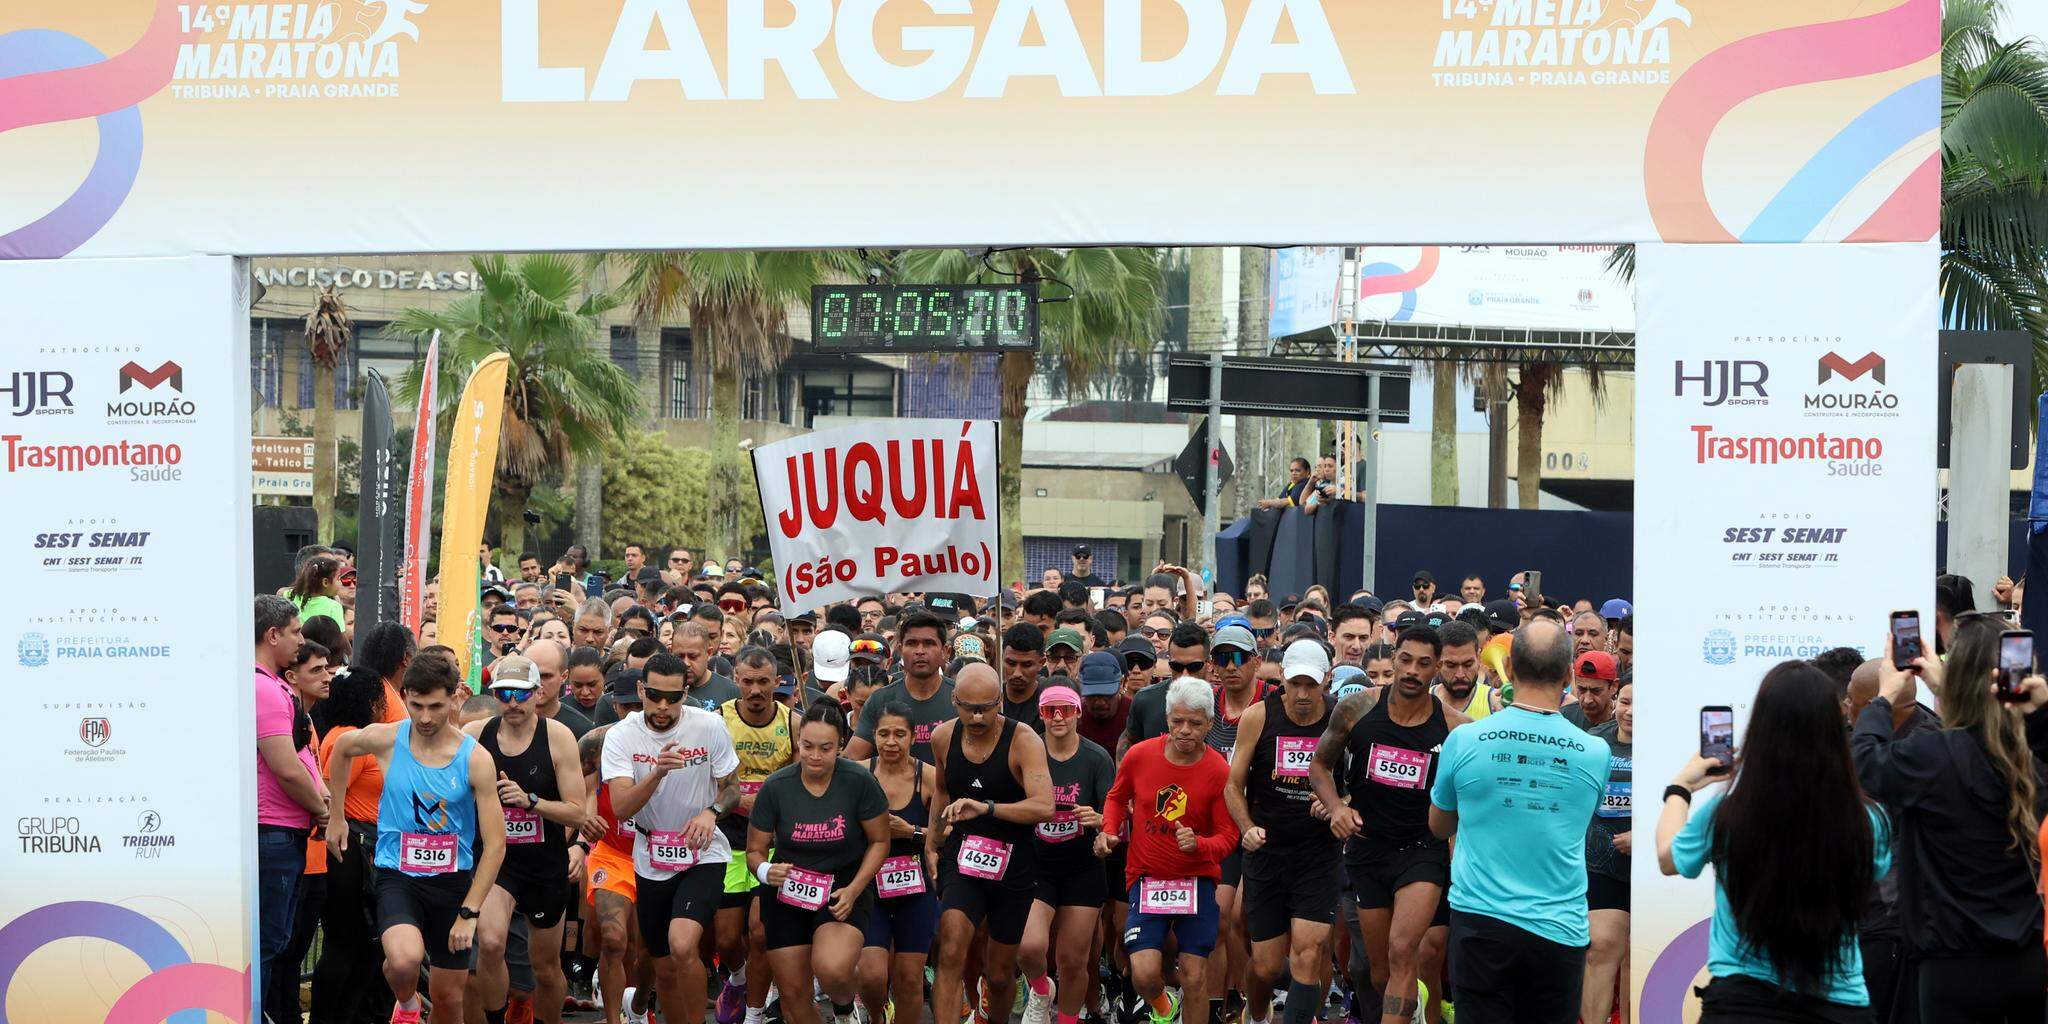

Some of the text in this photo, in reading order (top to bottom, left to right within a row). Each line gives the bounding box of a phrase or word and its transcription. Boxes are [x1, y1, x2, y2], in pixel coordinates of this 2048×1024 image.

[227, 3, 335, 40] MEIA
[502, 0, 1357, 102] LARGADA
[1432, 27, 1671, 67] MARATONA
[172, 41, 400, 80] MARATONA
[1432, 70, 1671, 87] TRIBUNA PRAIA GRANDE
[171, 83, 399, 99] TRIBUNA PRAIA GRANDE
[379, 270, 414, 290] DE
[416, 270, 486, 291] ASSI
[822, 291, 1026, 337] 07:05:00
[1674, 360, 1770, 407] HJR
[108, 398, 195, 417] MOURÃO
[1726, 397, 1770, 407] SPORTS
[1805, 391, 1898, 409] MOURÃO
[34, 407, 75, 417] SPORTS
[1690, 425, 1883, 464] Trasmontano
[2, 435, 182, 472] Trasmontano
[130, 466, 182, 482] Saúde
[1827, 458, 1883, 477] Saúde
[293, 479, 312, 488] Gra
[778, 421, 986, 539] JUQUIÁ
[34, 532, 150, 548] SEST SENAT
[1723, 528, 1847, 543] SEST SENAT
[68, 557, 92, 565] SEST
[94, 557, 124, 565] SENAT
[1759, 553, 1784, 561] SEST
[785, 541, 992, 604] (São Paulo)
[69, 608, 118, 616] APOIO
[56, 637, 130, 645] PREFEITURA
[1744, 635, 1823, 644] PREFEITURA
[57, 646, 170, 658] PRAIA GRANDE
[1745, 646, 1793, 657] PRAIA
[85, 721, 105, 741] FPA
[735, 740, 779, 753] BRASIL
[1478, 730, 1585, 753] COORDENAÇÃO
[64, 749, 126, 757] Federação Paulista
[1288, 752, 1313, 763] 394
[1379, 761, 1417, 777] 5503
[18, 817, 80, 835] GRUPO
[506, 821, 533, 832] 360
[1042, 821, 1074, 833] 4782
[123, 836, 175, 849] TRIBUNA
[791, 830, 844, 839] MARATONA
[19, 836, 102, 853] TRIBUNA
[134, 845, 161, 858] RUN
[657, 845, 688, 859] 5518
[414, 848, 446, 861] 5316
[964, 850, 999, 868] 4625
[886, 869, 916, 885] 4257
[788, 880, 818, 898] 3918
[1151, 890, 1188, 902] 4054
